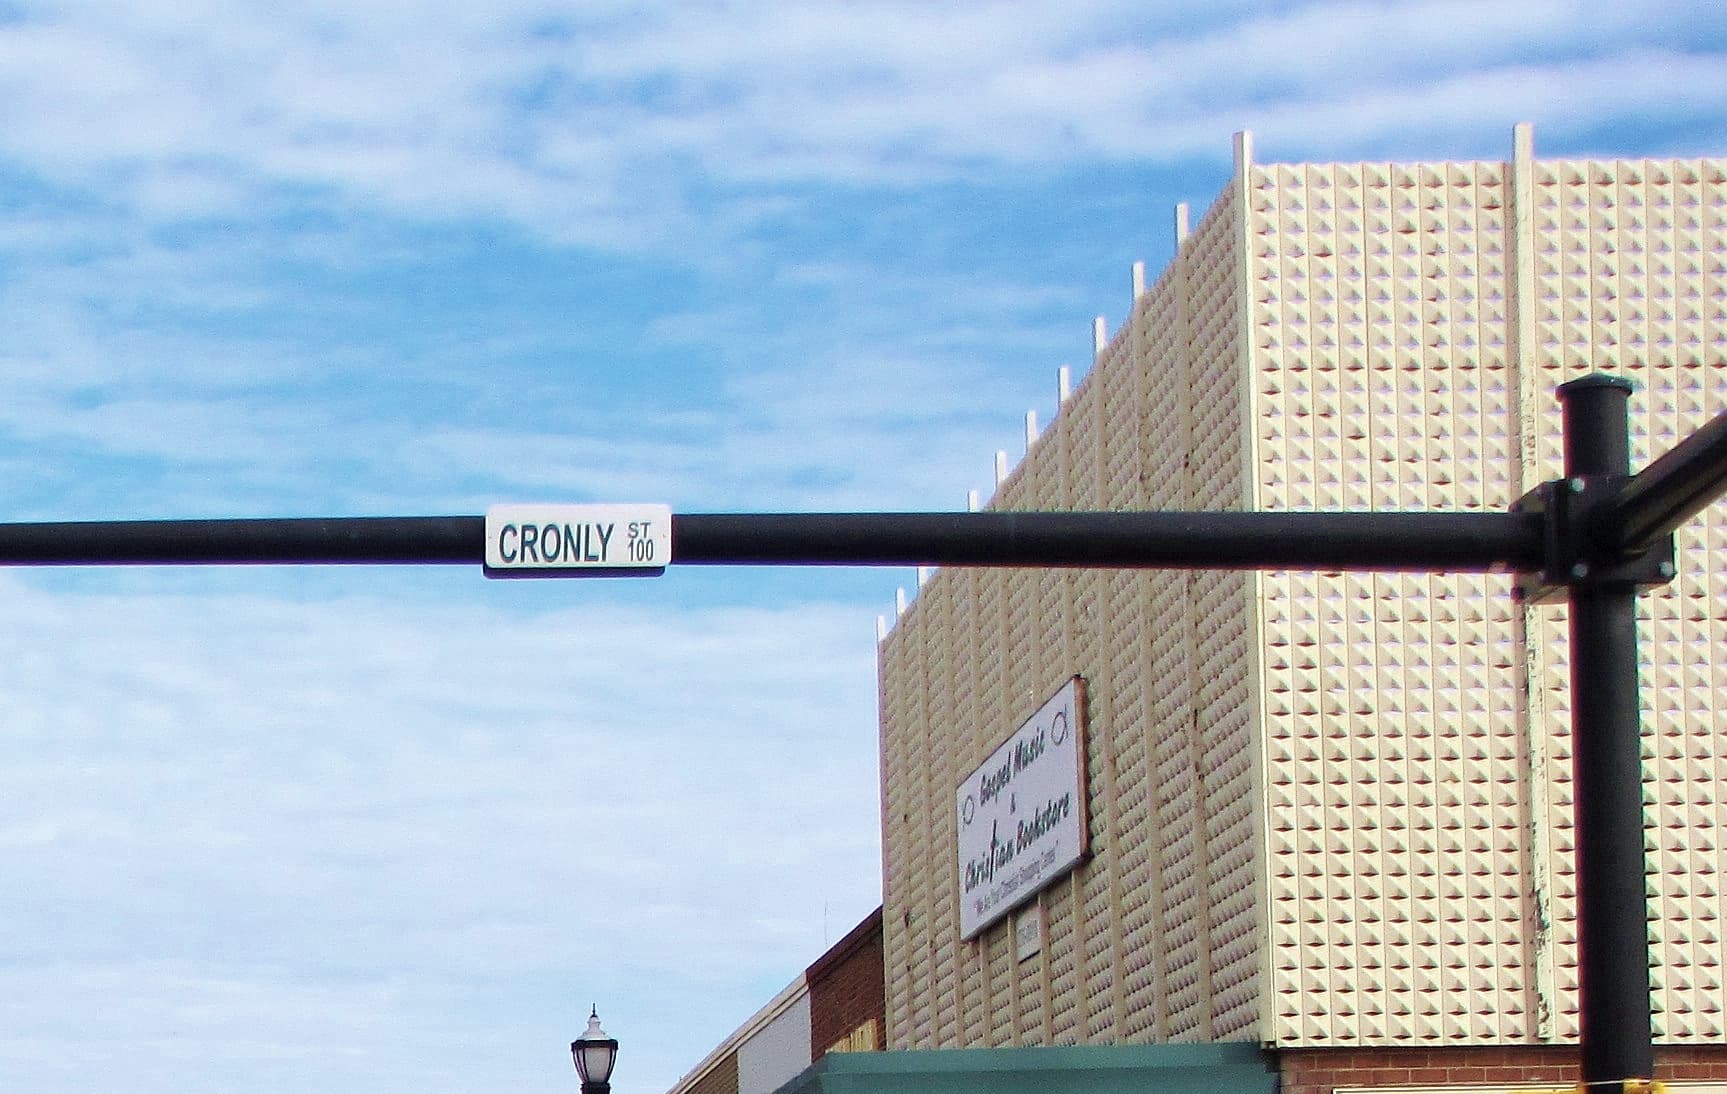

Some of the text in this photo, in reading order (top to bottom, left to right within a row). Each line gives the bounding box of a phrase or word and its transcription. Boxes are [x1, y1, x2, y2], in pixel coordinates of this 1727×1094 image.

[499, 522, 652, 563] CRONLY ST
[628, 539, 654, 562] 100
[979, 727, 1045, 804] Gospel Music
[965, 792, 1070, 893] Christian Bookstore
